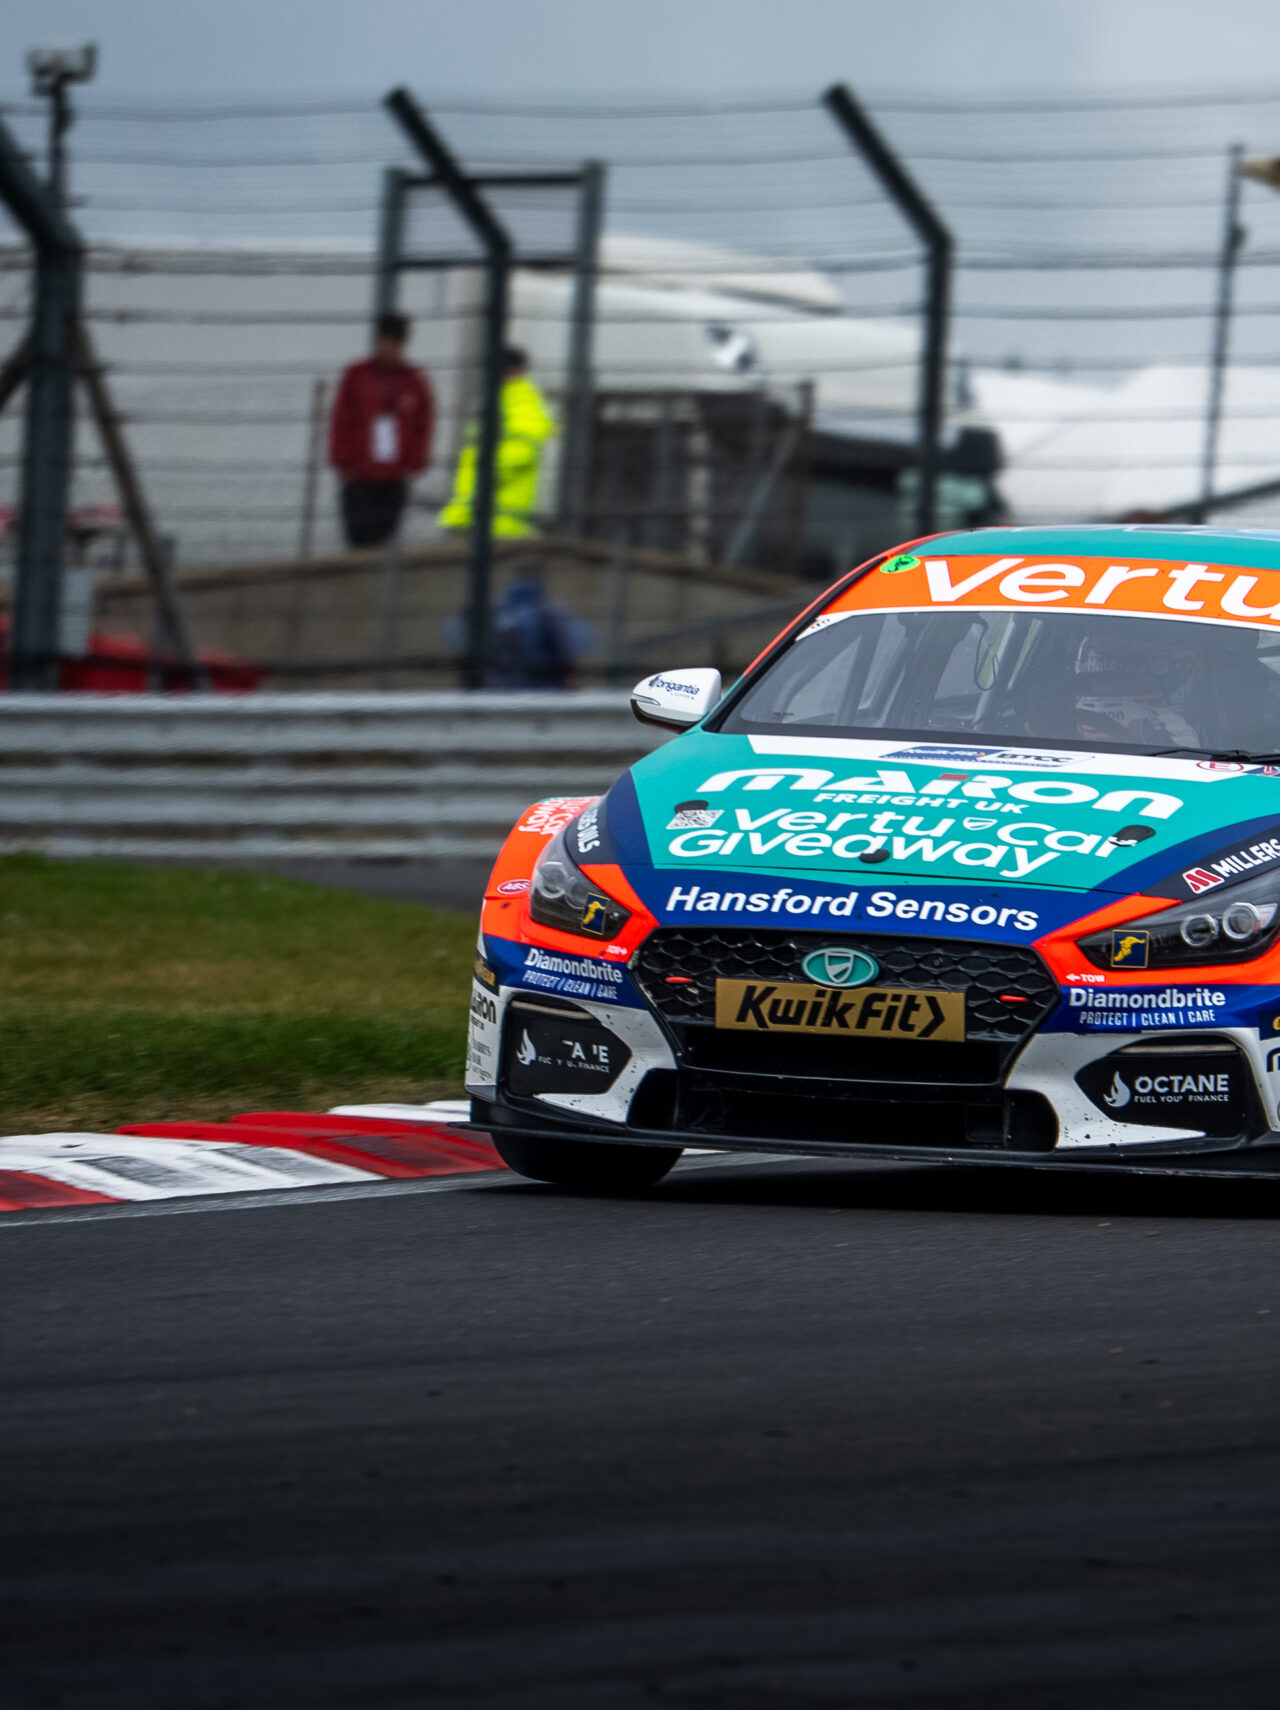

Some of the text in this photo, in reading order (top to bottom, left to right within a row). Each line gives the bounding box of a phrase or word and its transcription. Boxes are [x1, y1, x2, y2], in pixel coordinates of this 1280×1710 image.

[813, 792, 1030, 814] FREIGHT UK
[996, 822, 1138, 858] Car
[665, 886, 1040, 931] Hansford Sensors
[523, 948, 623, 984] Diamondbrite
[1080, 973, 1106, 983] TOW
[1069, 987, 1226, 1008] Diamondbrite
[1079, 1009, 1216, 1026] PROTECT CLEAN CARE
[1135, 1074, 1230, 1094] OCTANE
[1188, 1094, 1229, 1102] FINANCE
